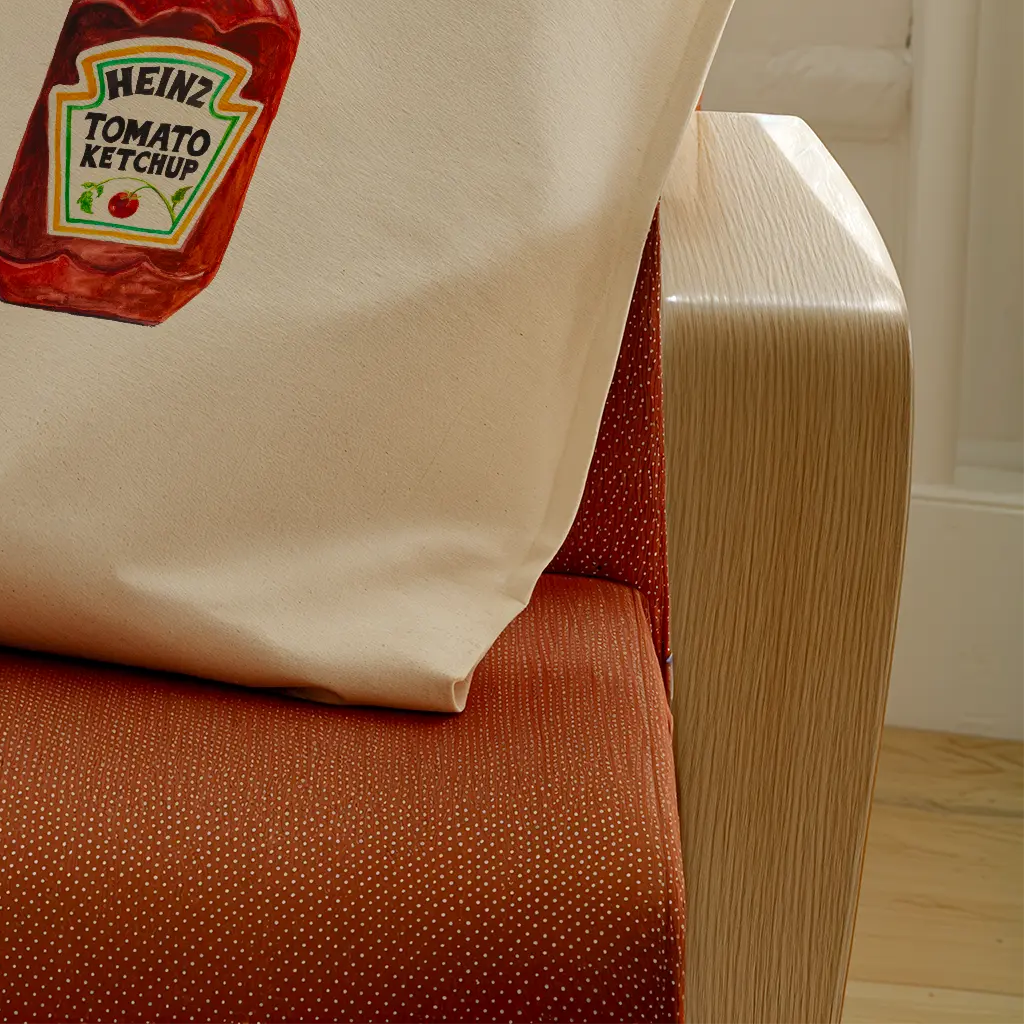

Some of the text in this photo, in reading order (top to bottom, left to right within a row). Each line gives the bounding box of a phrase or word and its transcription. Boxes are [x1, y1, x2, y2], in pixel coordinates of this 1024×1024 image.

[105, 65, 214, 108] HEINZ
[84, 111, 211, 156] TOMATO
[79, 143, 199, 181] KETCHUP
